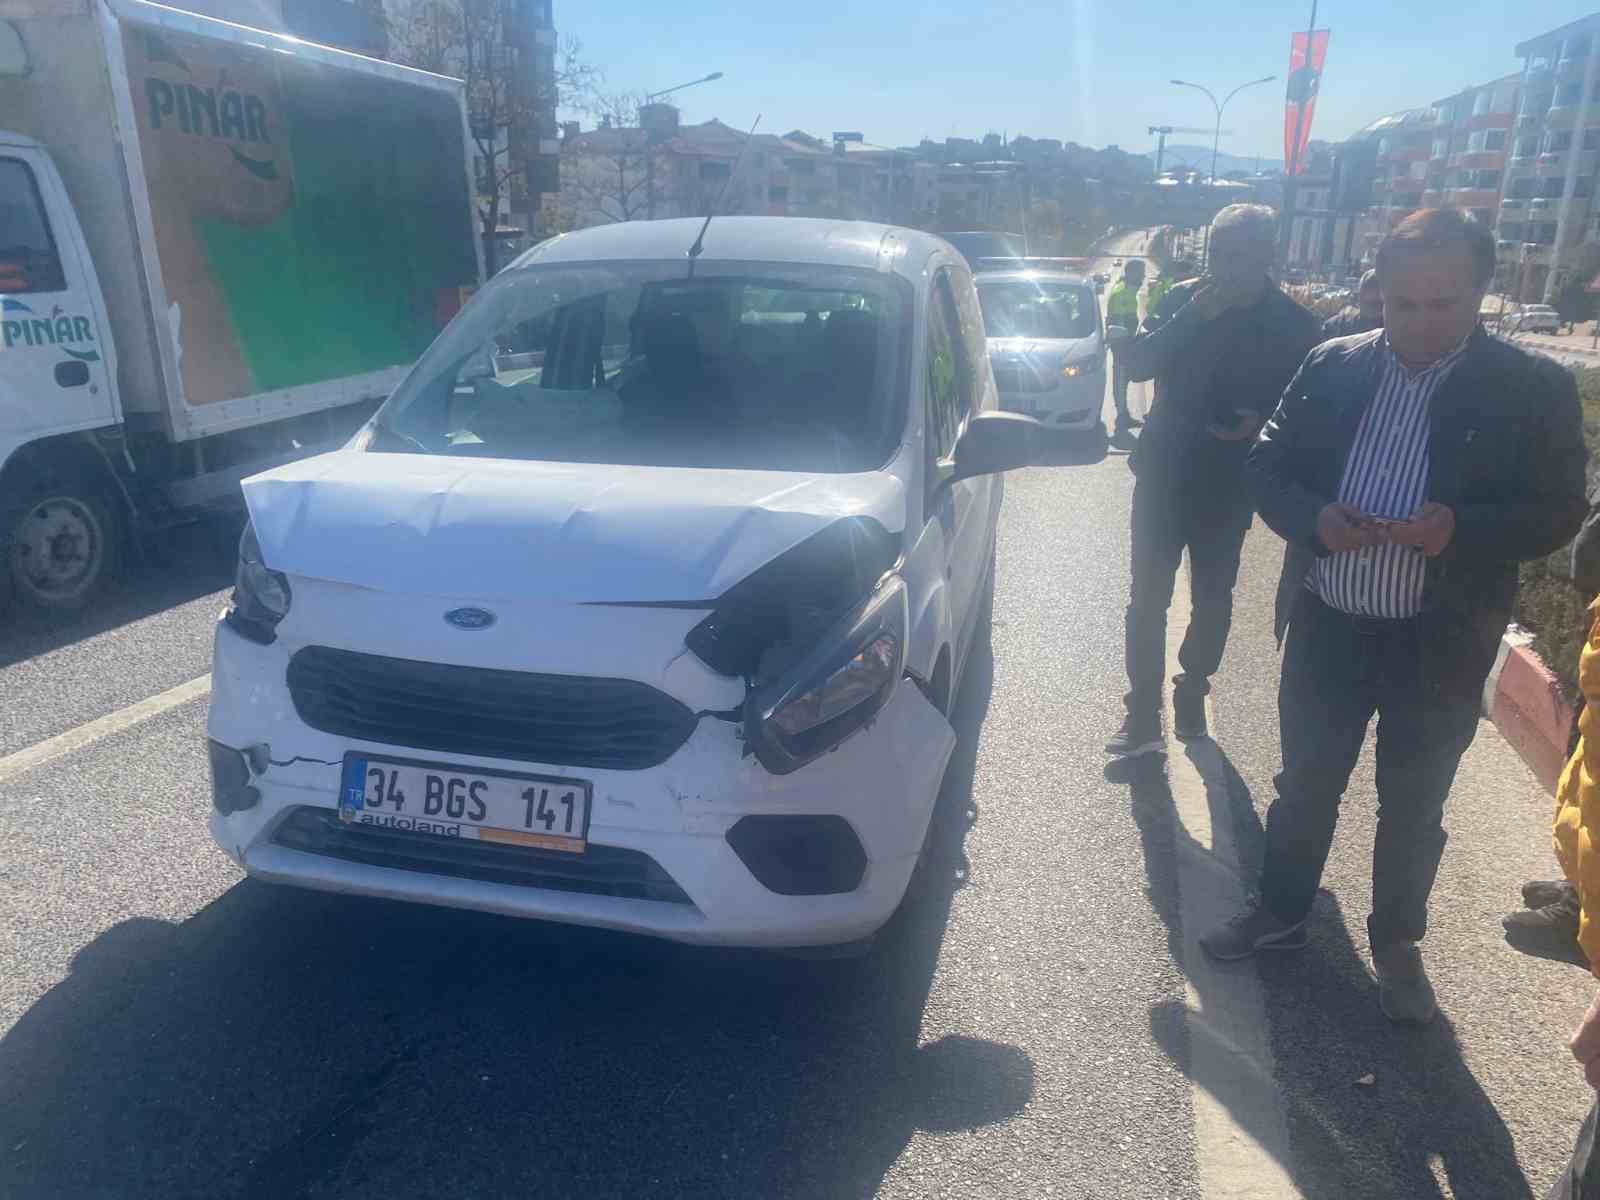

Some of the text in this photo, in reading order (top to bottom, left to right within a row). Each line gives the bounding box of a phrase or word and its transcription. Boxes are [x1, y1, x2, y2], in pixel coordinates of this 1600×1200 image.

[146, 78, 271, 144] PINAR
[1, 315, 95, 347] PINAR
[366, 768, 575, 833] 34 BGS 141
[361, 814, 461, 837] autoland
